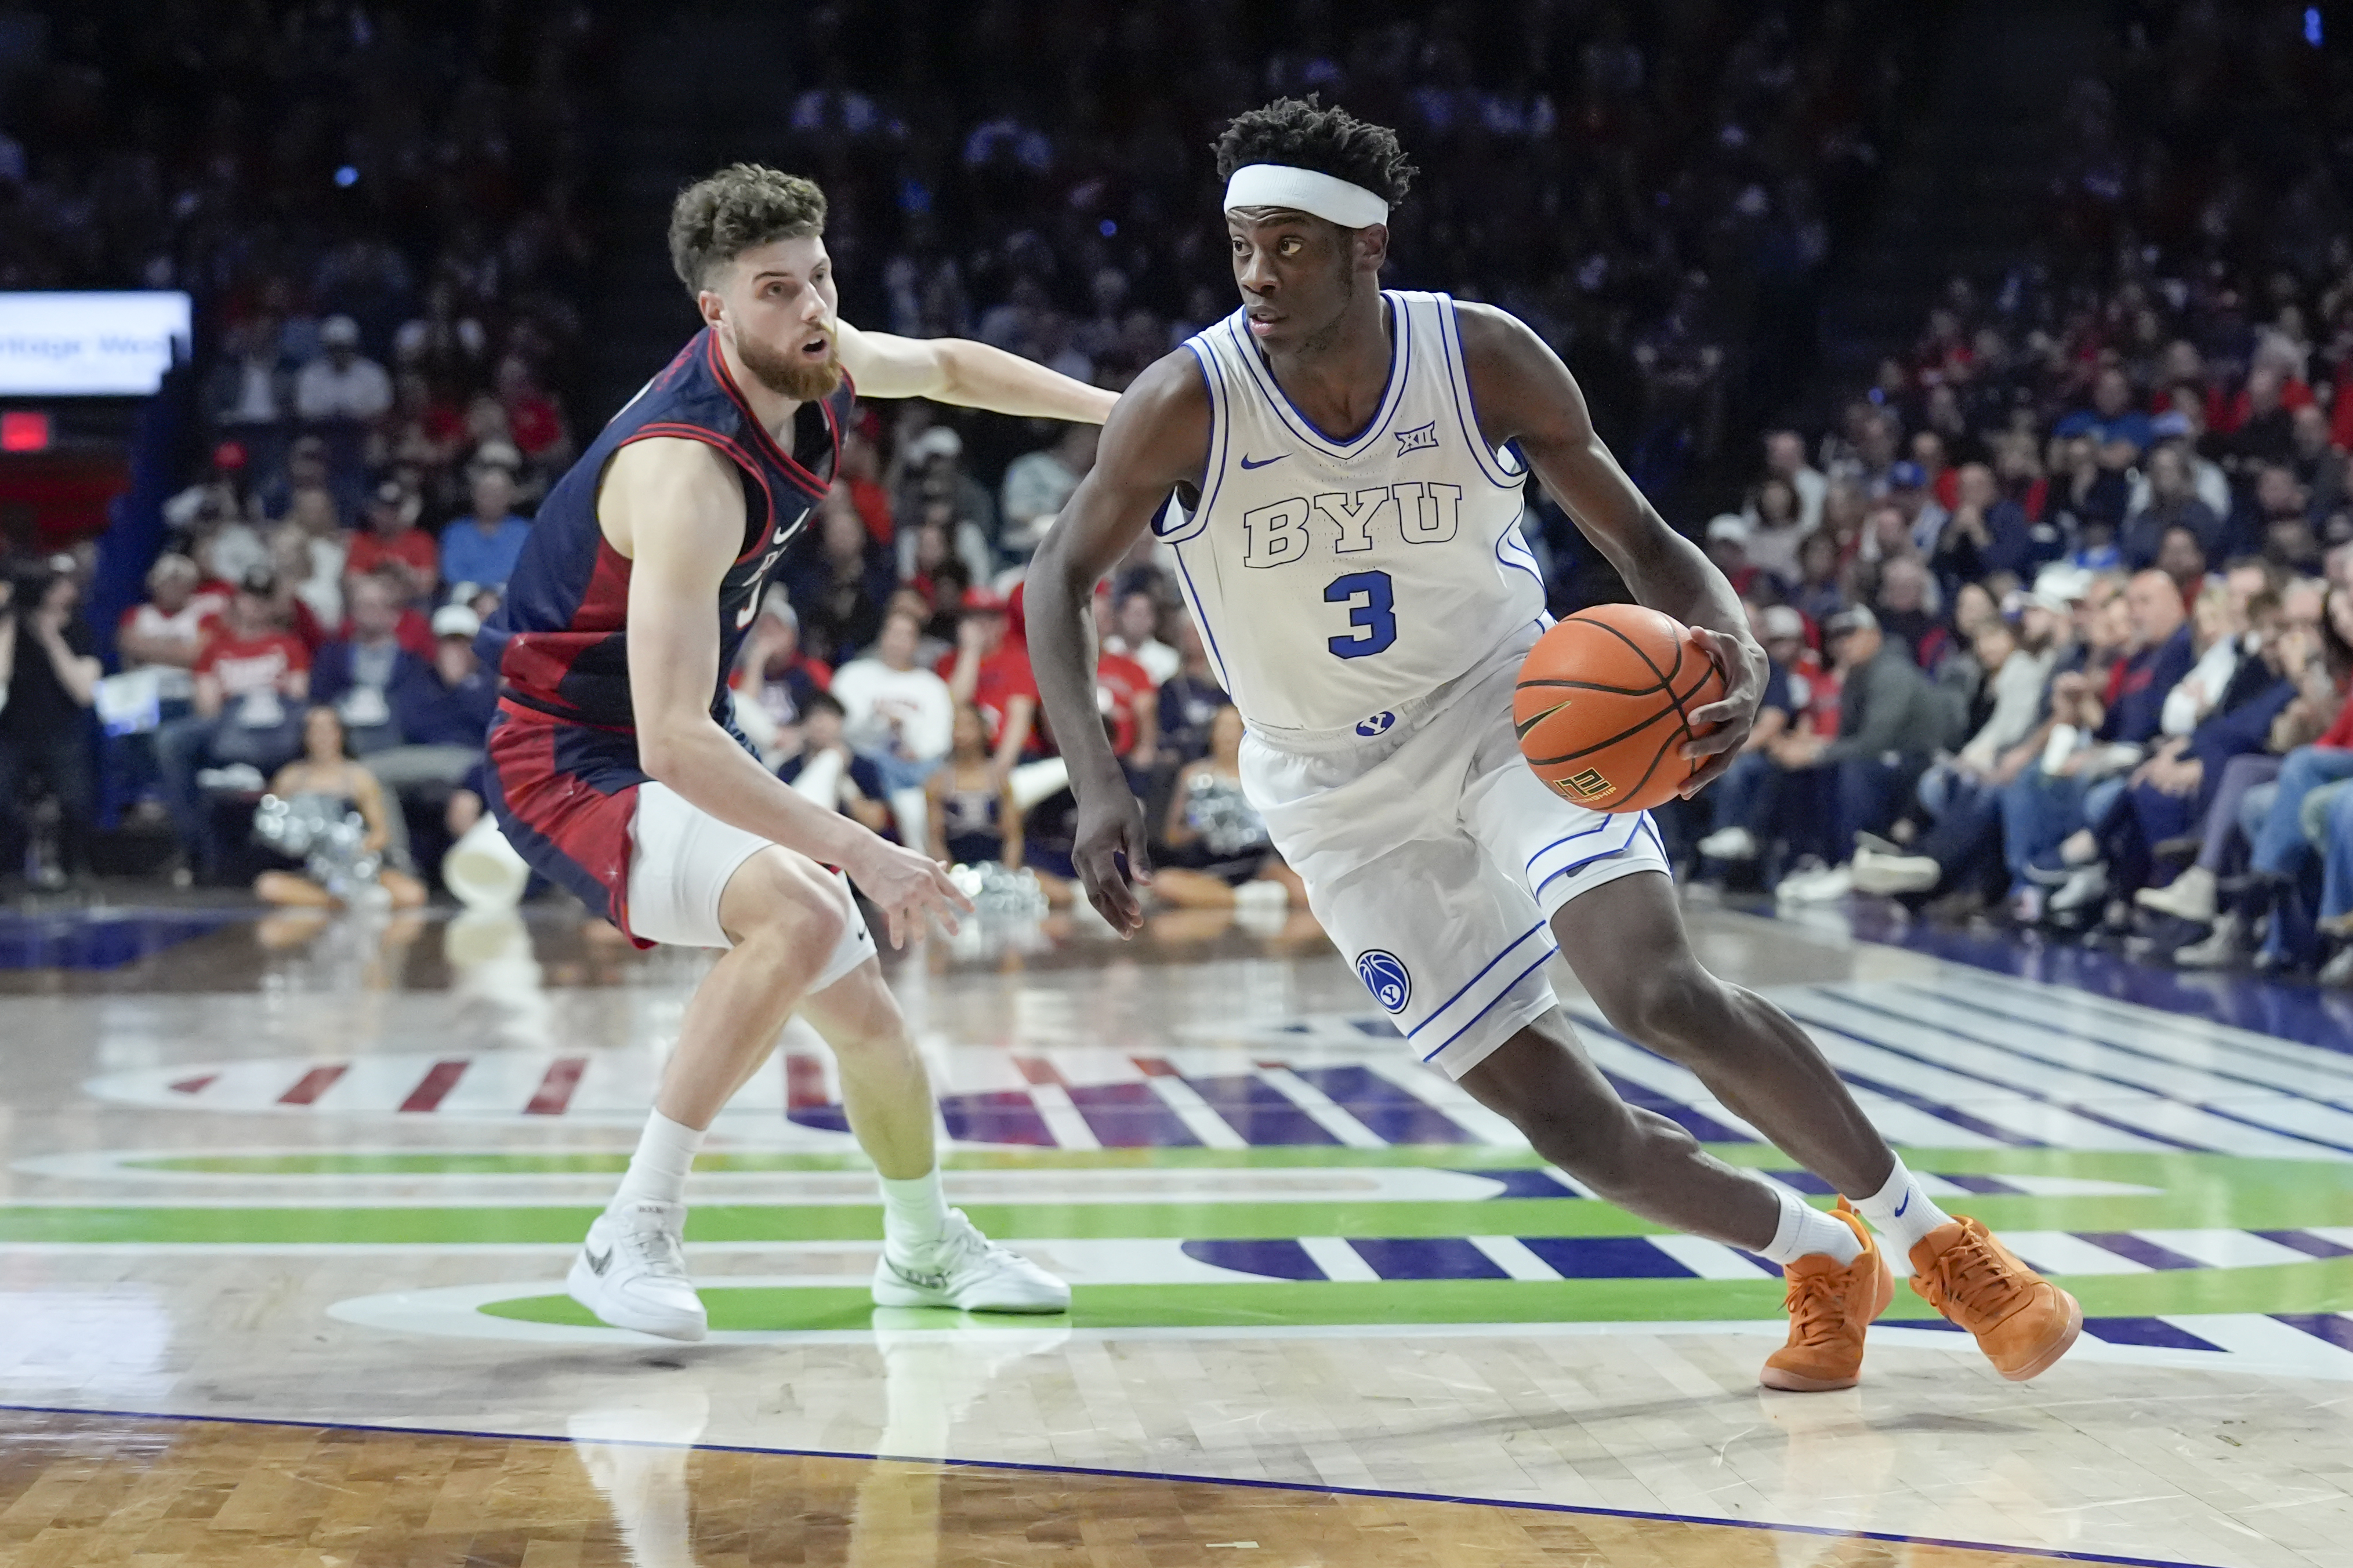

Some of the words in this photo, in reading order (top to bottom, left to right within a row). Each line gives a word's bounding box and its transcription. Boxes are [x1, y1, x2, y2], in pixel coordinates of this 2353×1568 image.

[1243, 482, 1462, 569] BYU
[1323, 569, 1397, 659] 3
[1359, 713, 1387, 735] Y
[1383, 986, 1397, 1003] Y
